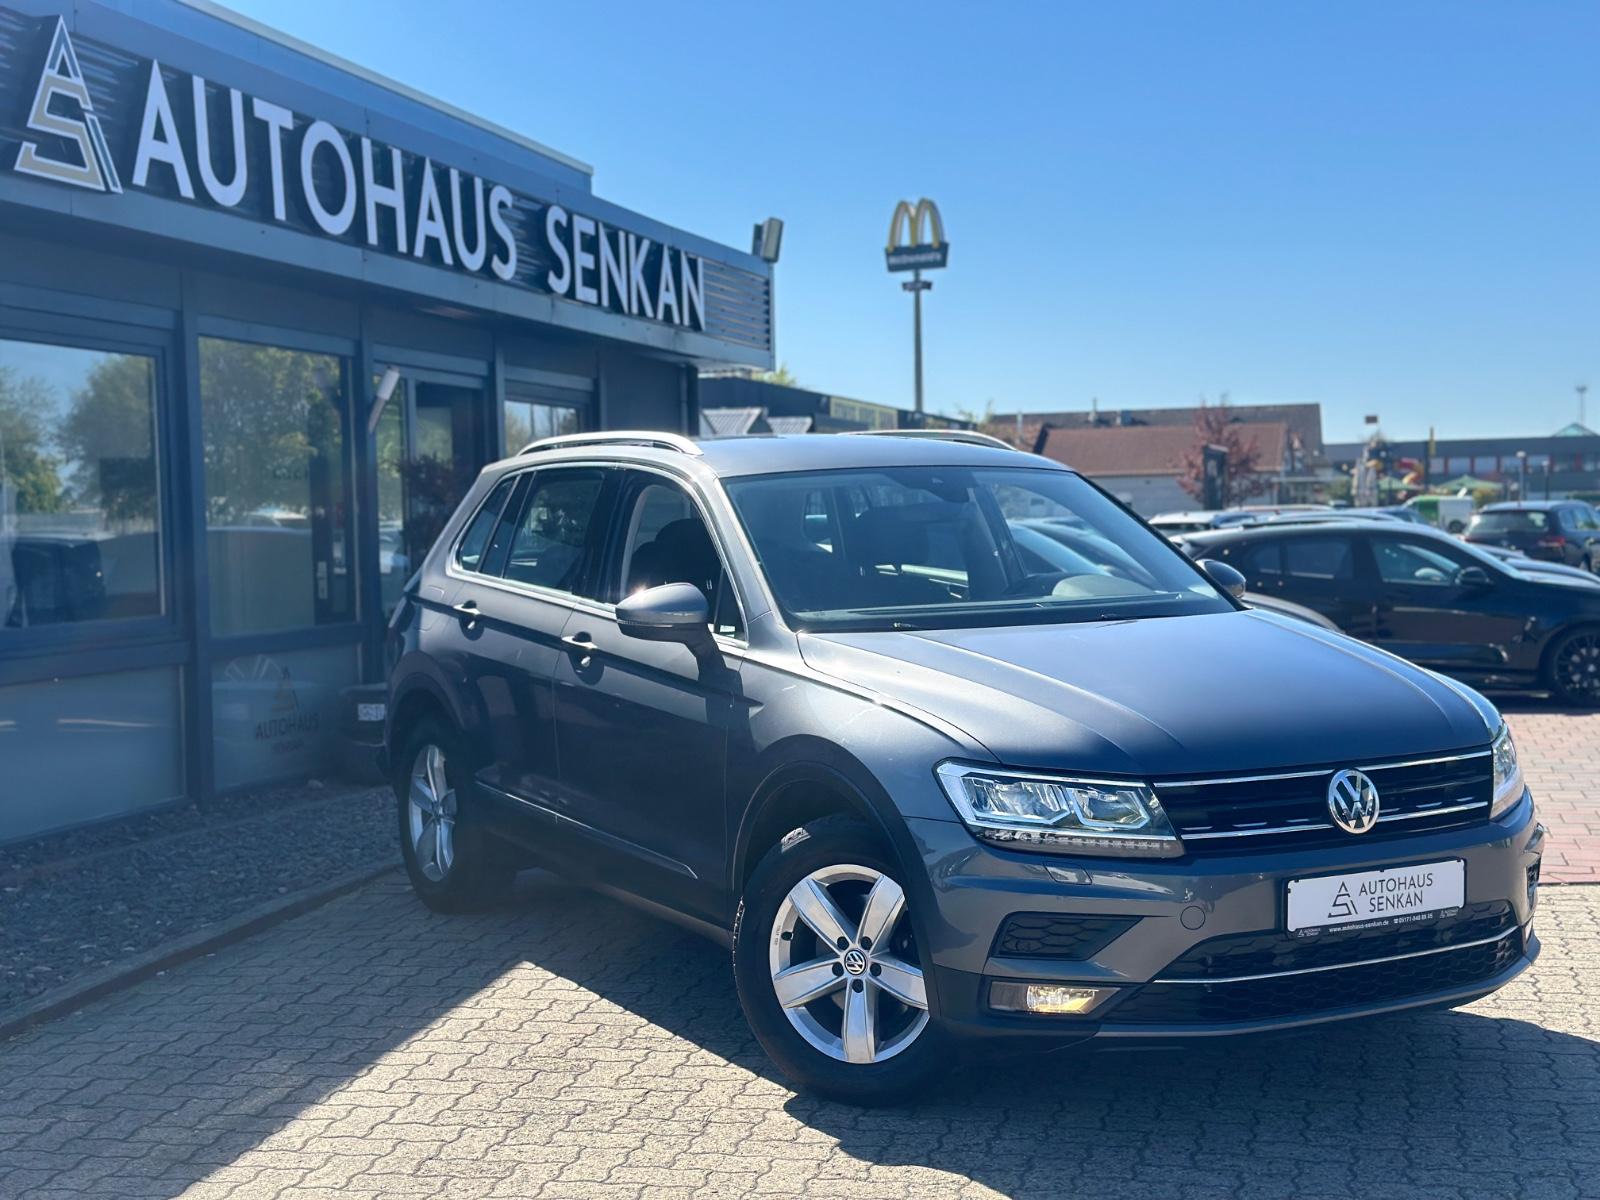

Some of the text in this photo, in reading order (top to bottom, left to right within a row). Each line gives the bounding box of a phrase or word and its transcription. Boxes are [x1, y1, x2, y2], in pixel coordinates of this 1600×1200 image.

[132, 58, 705, 332] AUTOHAUS SENKAN
[1358, 873, 1433, 896] AUTOHAUS
[1369, 890, 1423, 913] SENKAN
